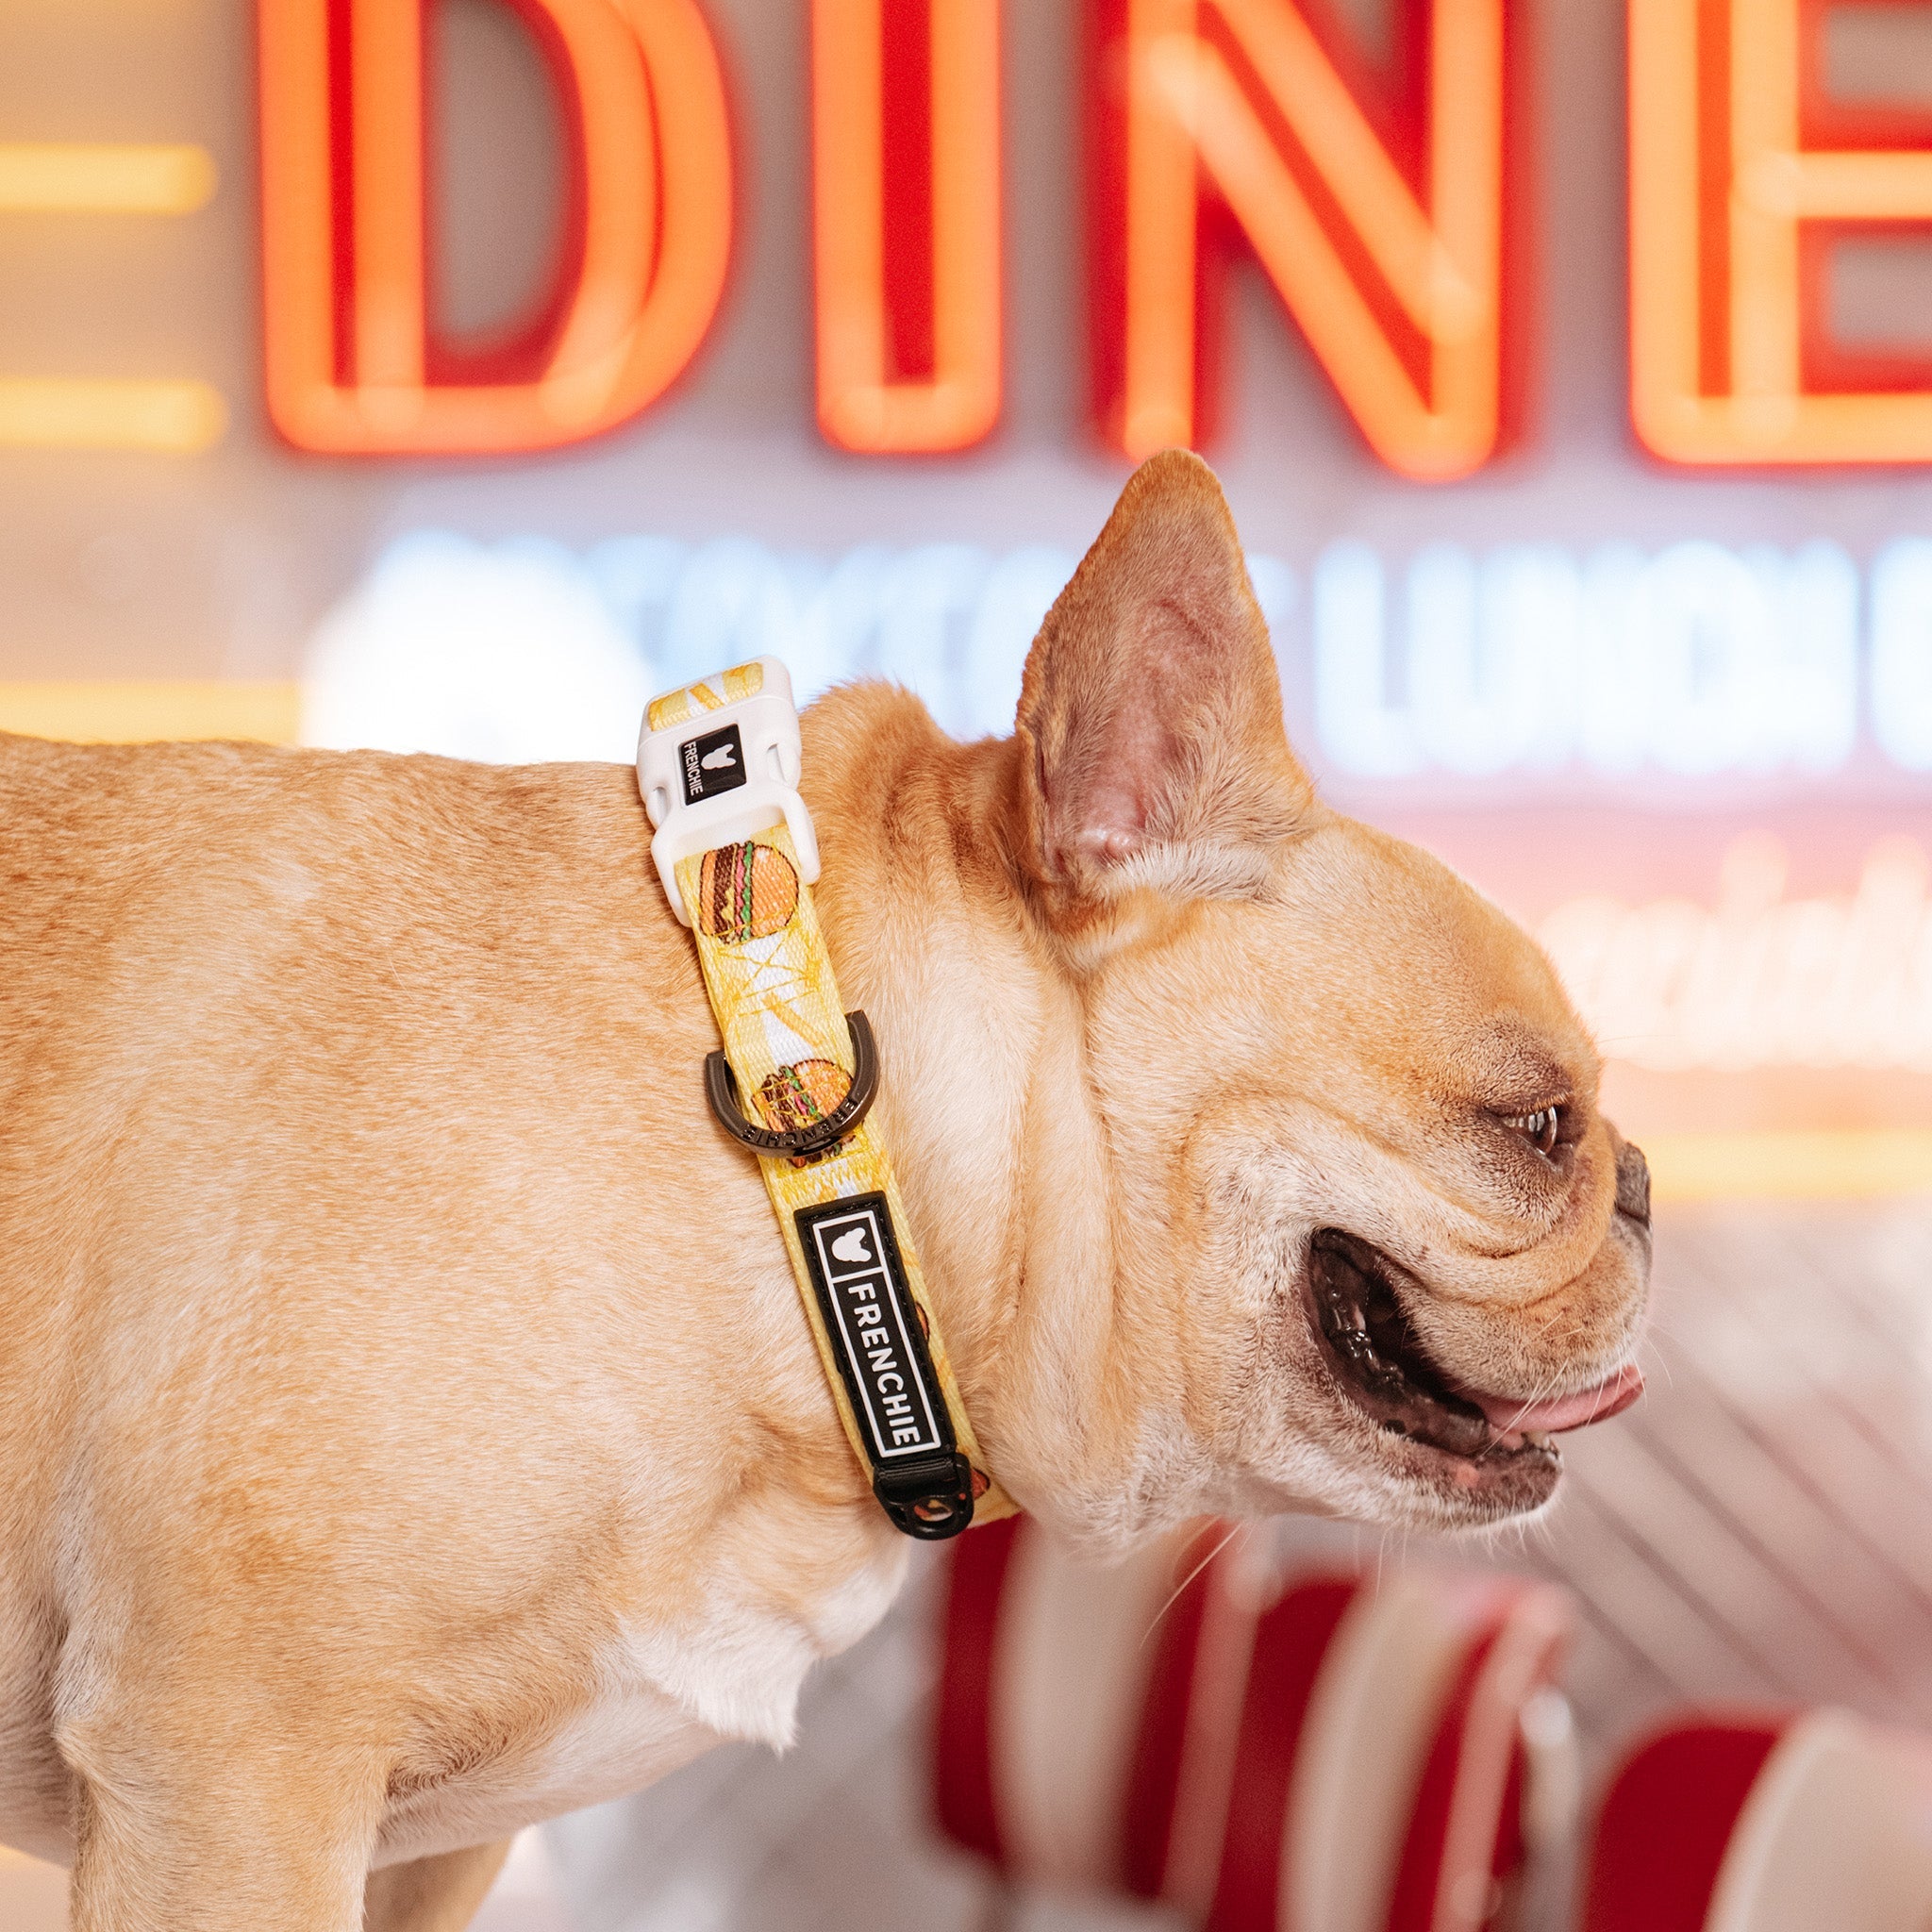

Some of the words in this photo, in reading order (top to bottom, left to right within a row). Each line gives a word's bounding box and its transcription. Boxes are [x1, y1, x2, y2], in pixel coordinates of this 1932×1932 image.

[684, 741, 704, 796] FRENCHIE
[741, 1097, 858, 1147] FRENCHIE
[847, 1281, 922, 1447] FRENCHIE
